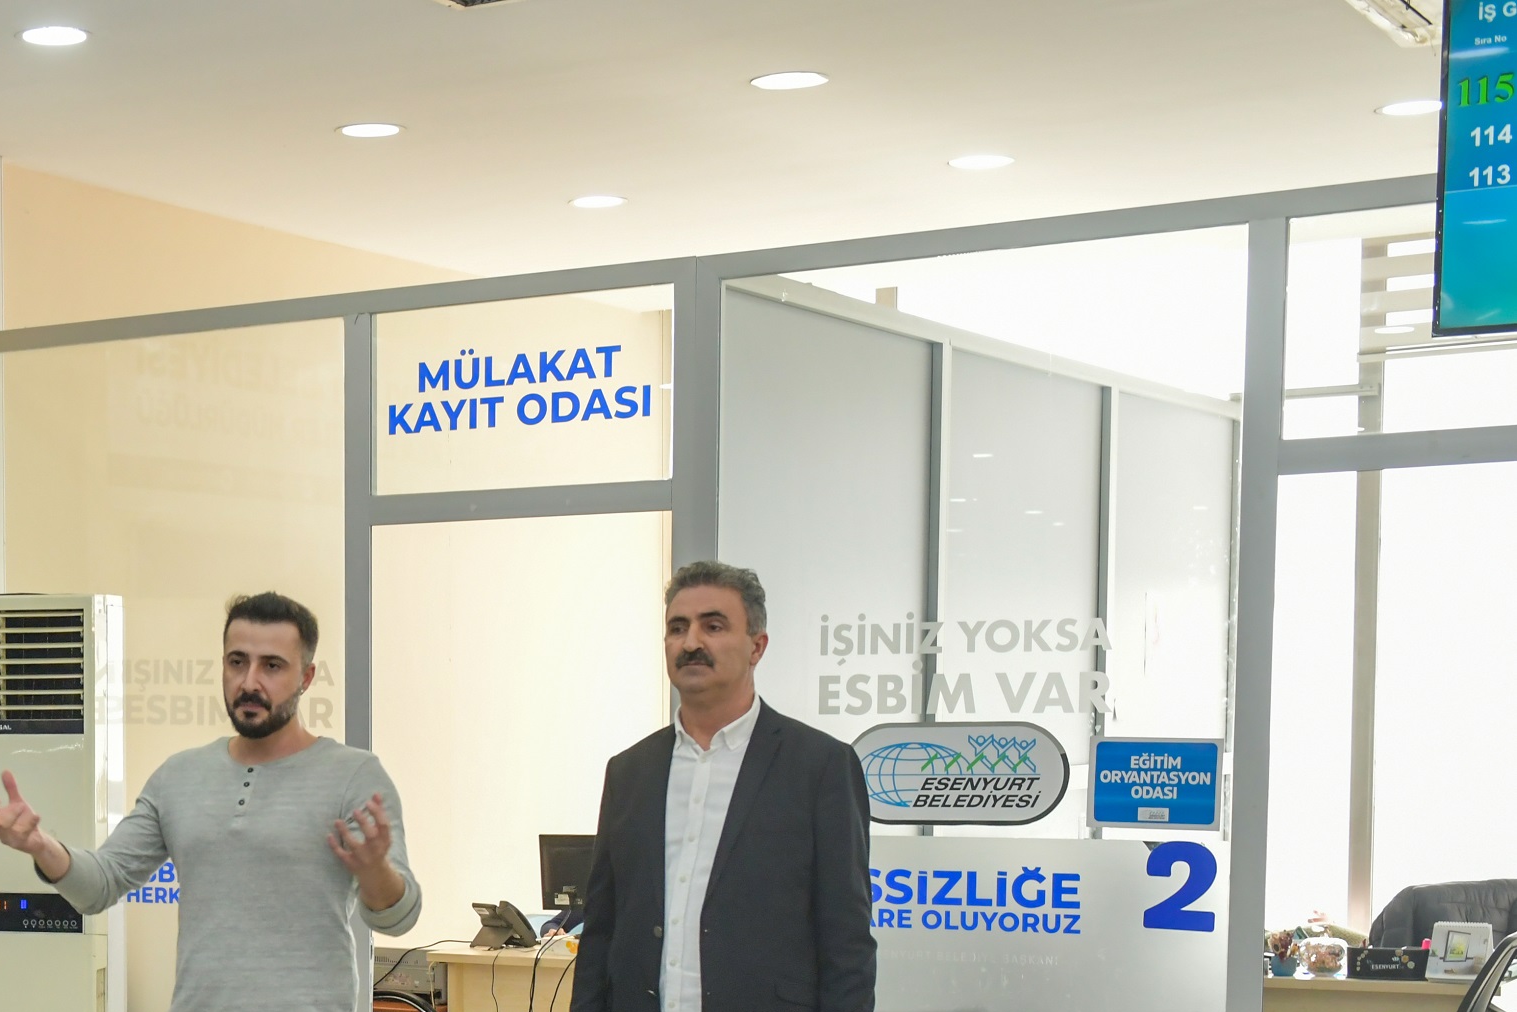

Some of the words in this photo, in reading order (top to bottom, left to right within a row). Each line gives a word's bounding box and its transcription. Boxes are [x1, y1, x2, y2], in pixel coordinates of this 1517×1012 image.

[1478, 1, 1497, 23] İŞ
[1494, 34, 1507, 43] No
[1458, 72, 1515, 107] 115
[1470, 124, 1513, 148] 114
[1468, 165, 1511, 188] 113
[418, 345, 622, 393] MÜLAKAT
[388, 396, 505, 435] KAYIT
[516, 385, 652, 426] ODASI
[820, 611, 944, 666] İŞİNİZ
[956, 617, 1113, 654] YOKSA
[818, 659, 977, 716] ESBİM
[994, 671, 1113, 714] VAR
[1130, 753, 1182, 770] EĞİTİM
[920, 777, 1041, 791] ESENYURT
[1099, 770, 1211, 785] ORYANTASYON
[912, 790, 1042, 808] BELEDİYESİ
[1130, 785, 1178, 800] ODASI
[126, 886, 180, 904] HERK
[1142, 841, 1218, 933] 2
[921, 909, 1081, 934] OLUYORUZ
